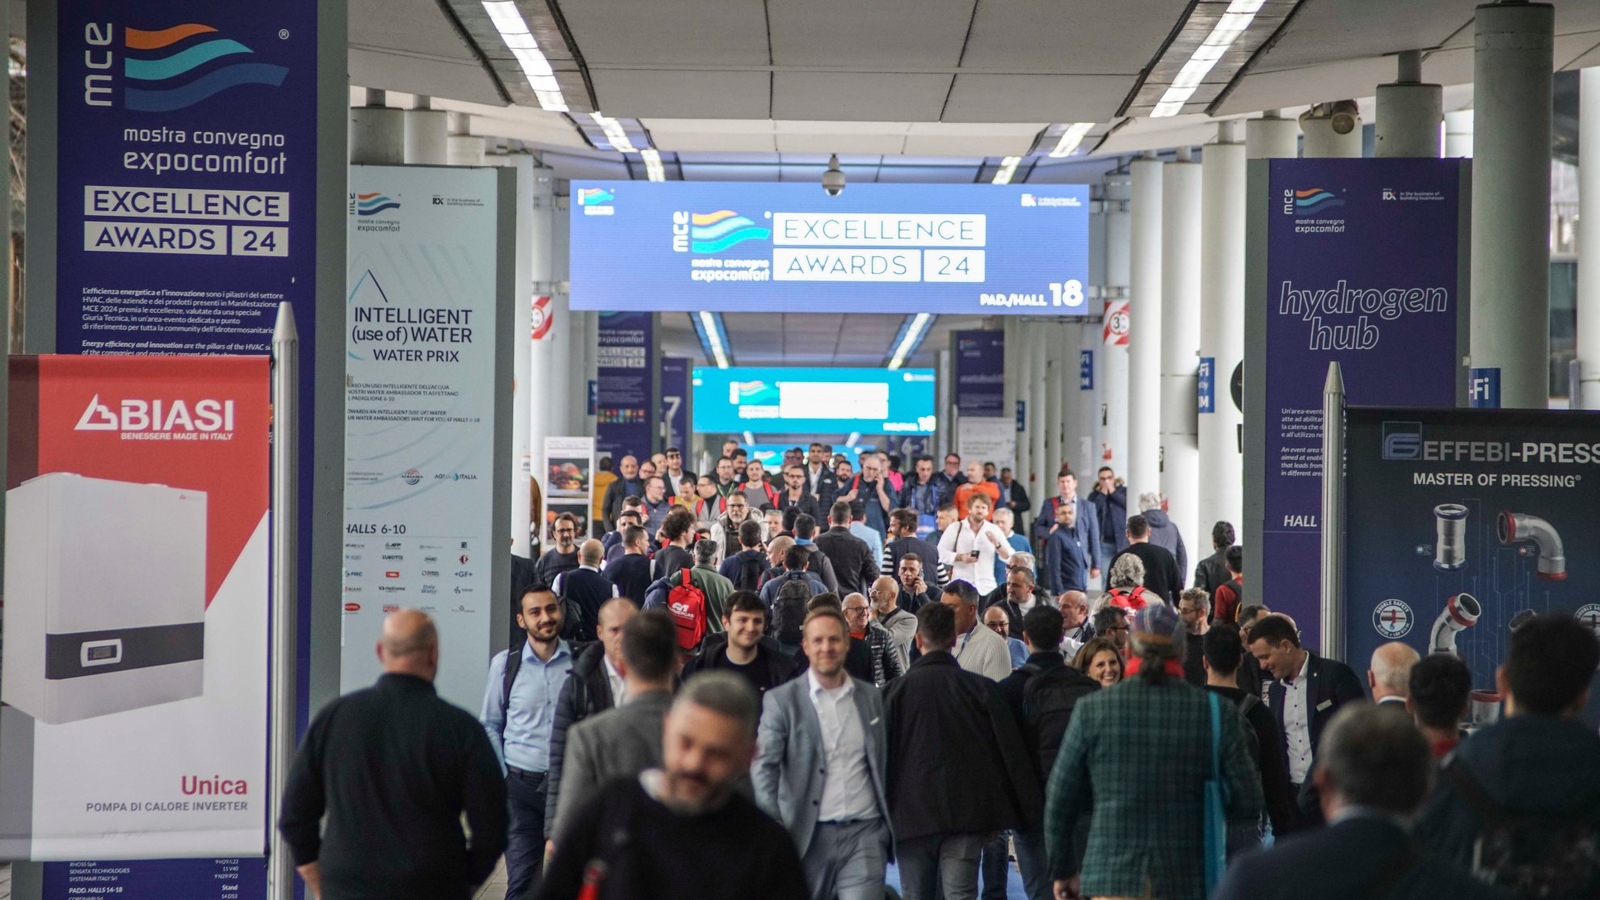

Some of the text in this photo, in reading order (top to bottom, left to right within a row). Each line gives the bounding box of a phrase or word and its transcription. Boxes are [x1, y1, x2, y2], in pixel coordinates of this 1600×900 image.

[85, 22, 112, 106] mce
[124, 126, 285, 149] mostra convegno
[124, 151, 286, 174] expocomfort
[94, 190, 280, 216] EXCELLENCE
[1284, 189, 1293, 214] mce
[95, 226, 276, 252] AWARDS 24
[672, 211, 688, 252] mce
[785, 219, 974, 240] EXCELLENCE
[692, 258, 769, 269] mostra convegno
[787, 255, 970, 275] AWARDS 24
[692, 268, 770, 283] expocomfort
[1049, 279, 1084, 307] 18
[1279, 280, 1448, 321] hydrogen
[355, 307, 472, 324] INTELLIGENT
[352, 326, 472, 345] (use of) WATER
[1309, 316, 1379, 350] hub
[82, 340, 104, 348] Energy
[373, 349, 459, 362] WATER PRIX
[121, 399, 234, 431] BIASI
[1413, 472, 1473, 486] MASTER
[1478, 473, 1497, 486] OF
[381, 524, 406, 534] 6-10
[1284, 515, 1317, 527] HALL
[182, 775, 248, 796] Unica
[86, 802, 248, 812] POMPA DI CALORE INVERTER
